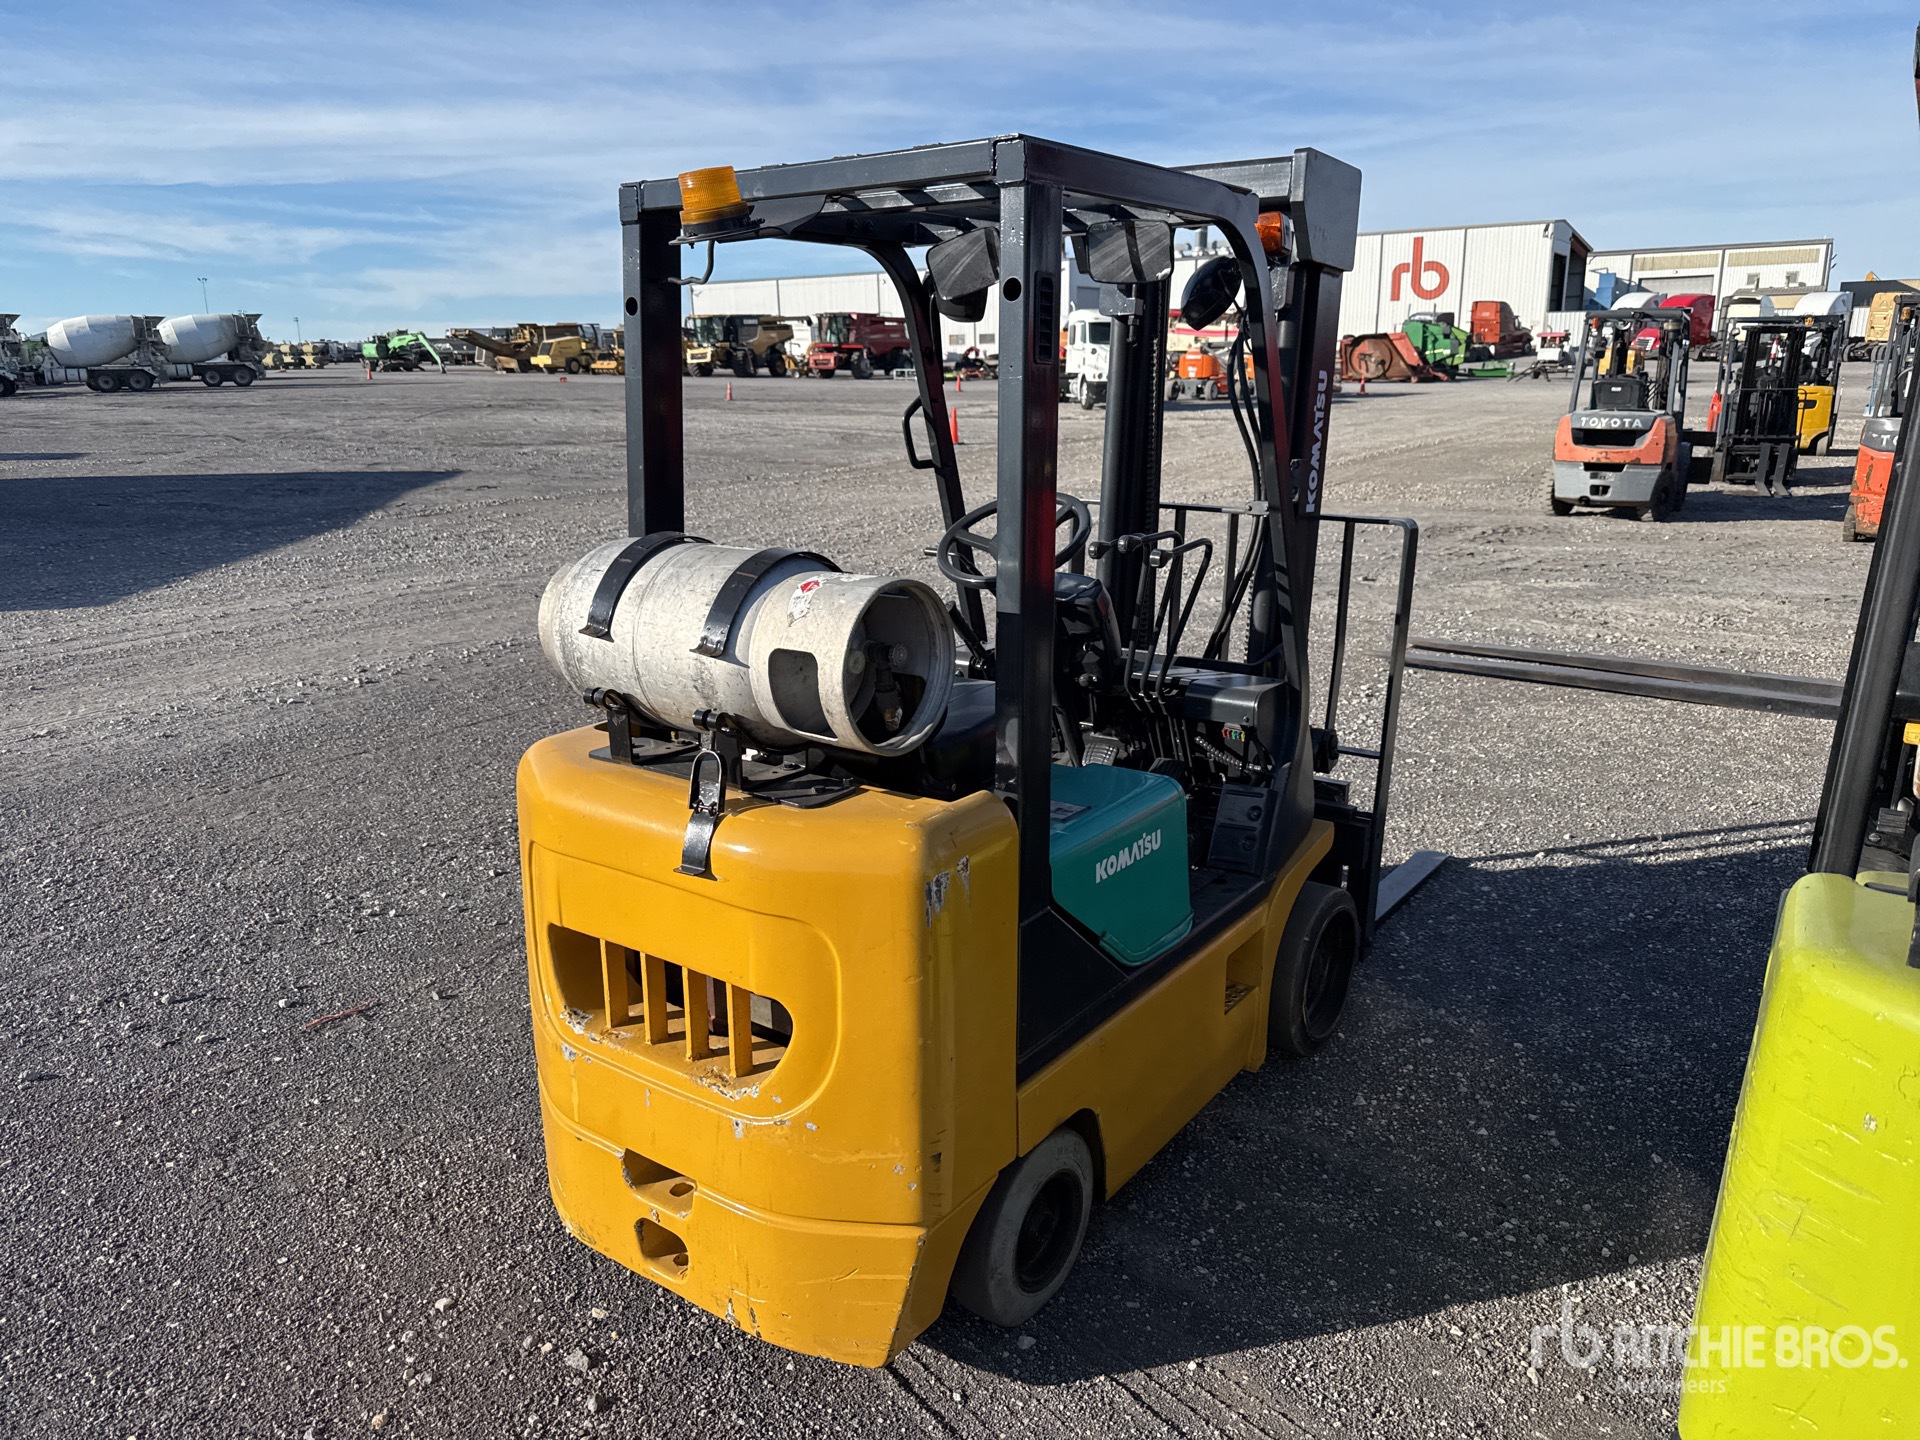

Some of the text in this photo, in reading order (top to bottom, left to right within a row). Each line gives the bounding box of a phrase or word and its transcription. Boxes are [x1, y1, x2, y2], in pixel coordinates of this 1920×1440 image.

[1390, 236, 1450, 302] rb
[1305, 370, 1328, 513] KOMATSU
[1580, 416, 1643, 428] TOYOTA
[1095, 828, 1162, 884] KOMATSU
